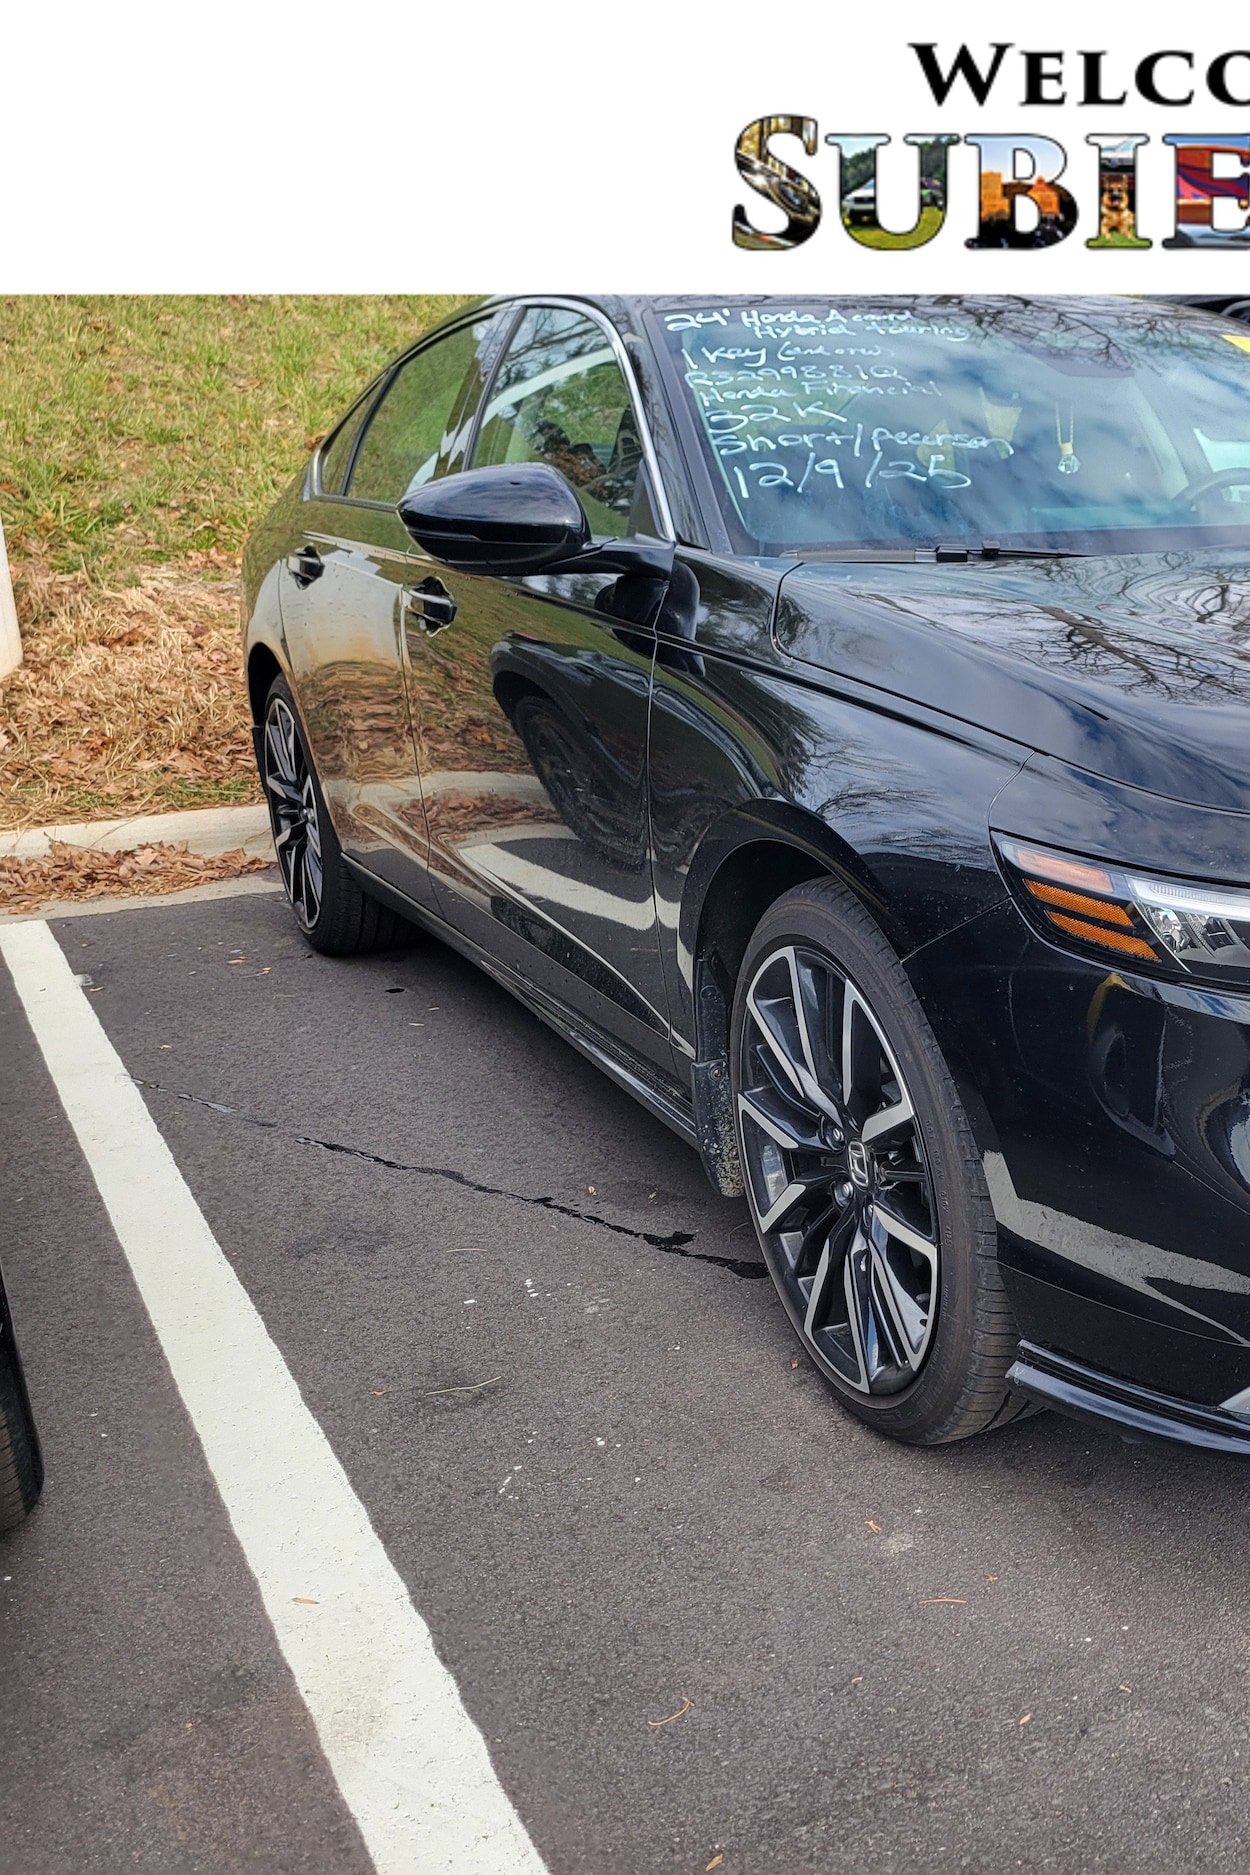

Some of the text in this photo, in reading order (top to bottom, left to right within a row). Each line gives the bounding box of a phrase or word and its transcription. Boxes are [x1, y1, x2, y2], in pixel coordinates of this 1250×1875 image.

[741, 309, 822, 328] Honda
[752, 324, 857, 339] Hybrid
[698, 380, 943, 408] Honda Financial
